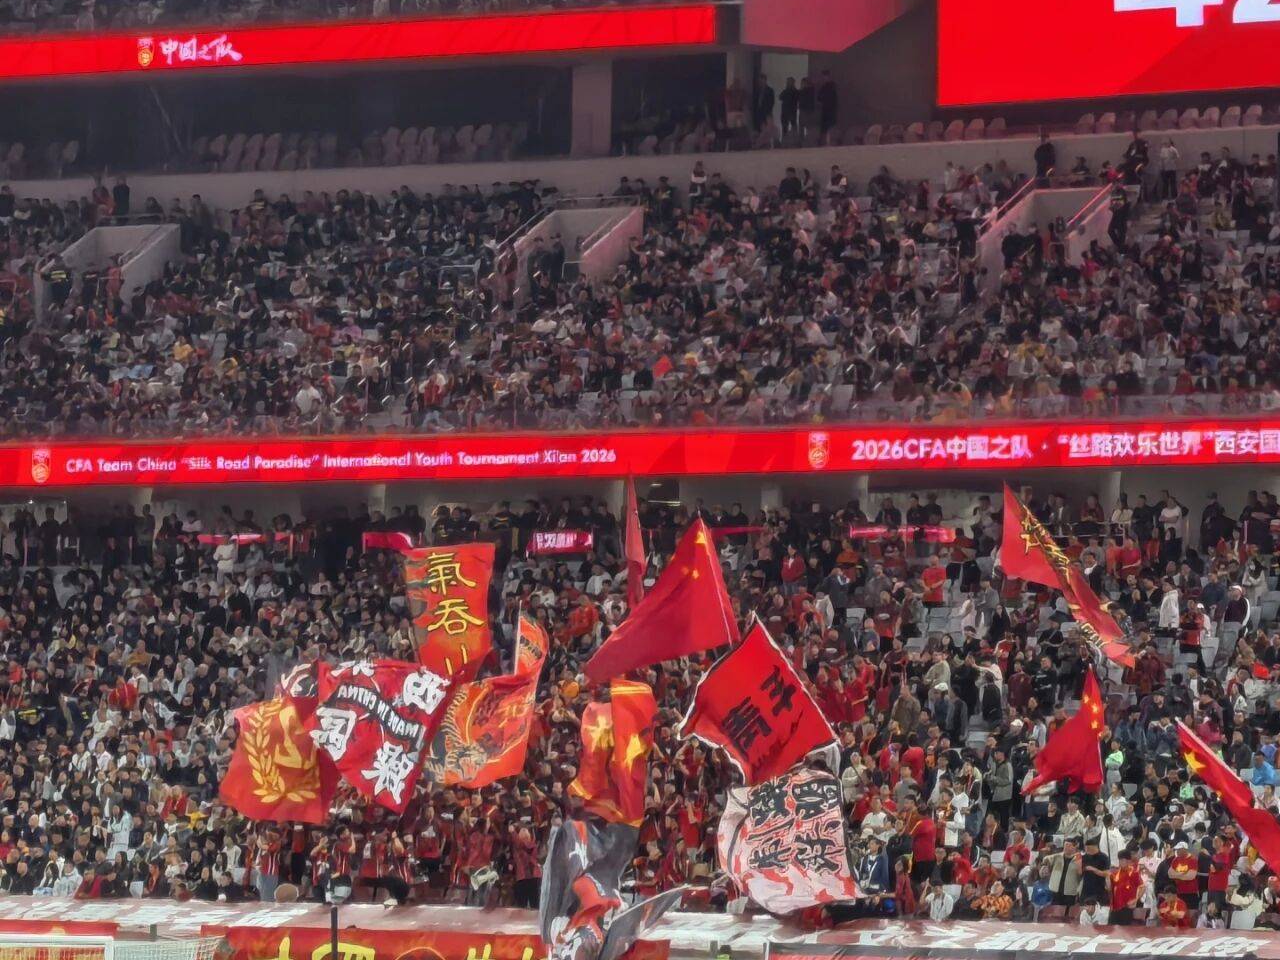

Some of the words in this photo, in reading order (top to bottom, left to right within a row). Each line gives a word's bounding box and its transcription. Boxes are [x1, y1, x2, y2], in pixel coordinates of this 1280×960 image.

[66, 458, 93, 472] CFA
[98, 458, 132, 472] Team
[138, 457, 176, 471] China
[217, 455, 249, 469] Road
[323, 453, 411, 468] International
[415, 452, 452, 466] Youth
[458, 451, 539, 465] Tournament
[582, 448, 617, 462] 2026
